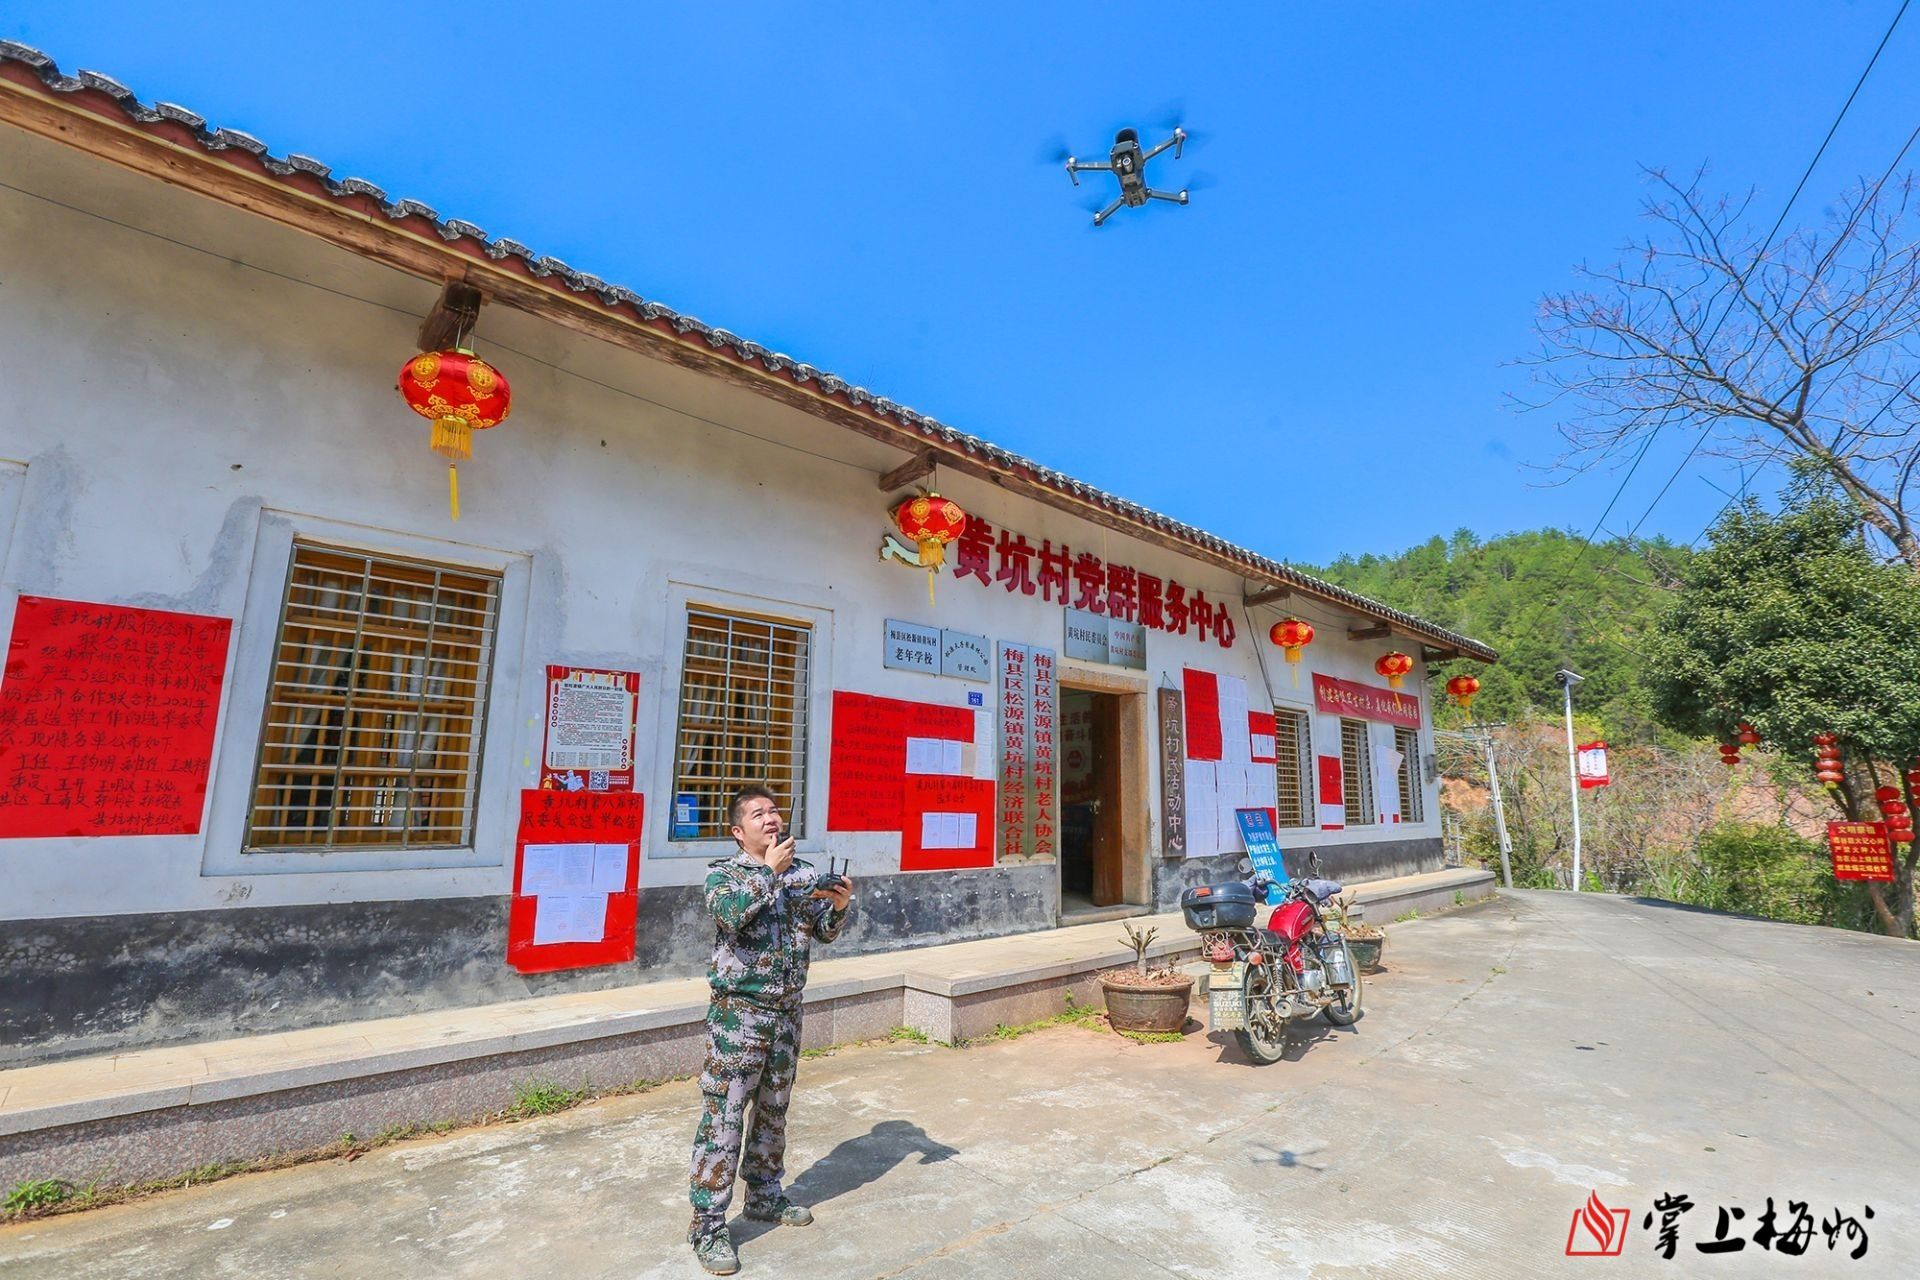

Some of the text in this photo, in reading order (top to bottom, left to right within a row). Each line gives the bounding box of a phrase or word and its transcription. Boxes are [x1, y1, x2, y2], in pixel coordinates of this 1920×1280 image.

[890, 630, 937, 647] 梅县区松源镇黄坑村
[952, 515, 1237, 648] 黄坑村党群服务中心
[1068, 626, 1108, 647] 黄坑村民委员会
[896, 647, 933, 665] 老年学校
[1002, 647, 1025, 856] 梅县区松源镇黄坑村经济联合社
[1033, 653, 1053, 855] 梅县区松源镇黄坑村老人协会
[1165, 696, 1184, 850] 黄坑村民活动中心
